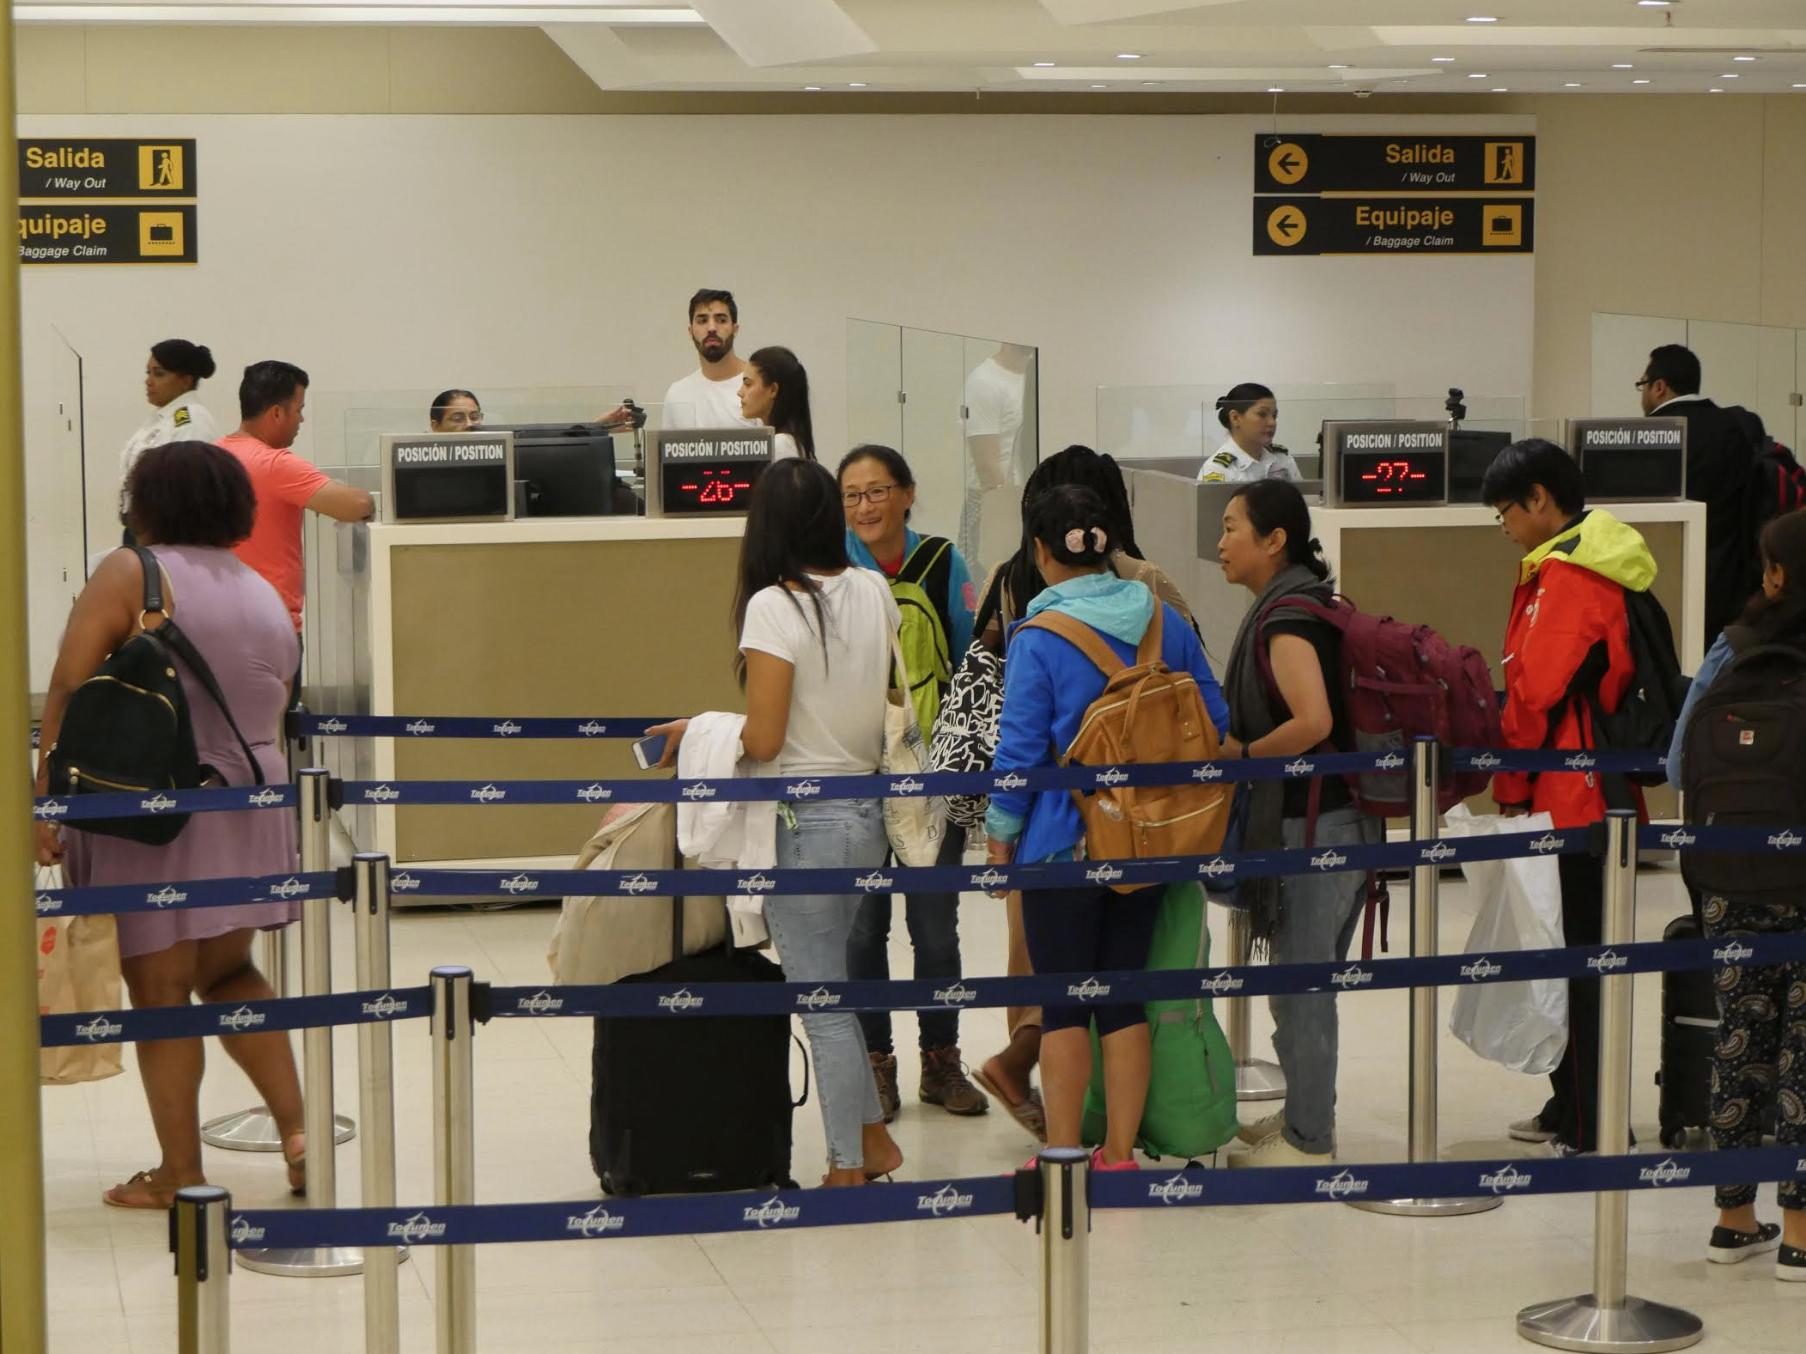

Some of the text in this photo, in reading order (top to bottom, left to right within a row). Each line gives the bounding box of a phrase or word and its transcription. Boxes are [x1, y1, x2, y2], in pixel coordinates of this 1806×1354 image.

[26, 147, 105, 168] Salida
[1386, 143, 1455, 164] Salida
[54, 178, 81, 191] Way
[84, 178, 106, 189] Out
[1409, 172, 1433, 185] Way
[1435, 172, 1455, 183] Out
[1356, 206, 1454, 230] Equipaje
[19, 213, 106, 240] quipaje
[1373, 236, 1420, 248] Baggage
[1423, 235, 1454, 246] Claim
[73, 245, 107, 256] Claim
[1399, 433, 1442, 447] POSITION
[1637, 430, 1680, 444] POSITION
[398, 443, 447, 462] POSICIÓN
[455, 445, 503, 460] POSITION
[665, 439, 713, 458] POSICIÓN
[721, 440, 768, 456] POSITION
